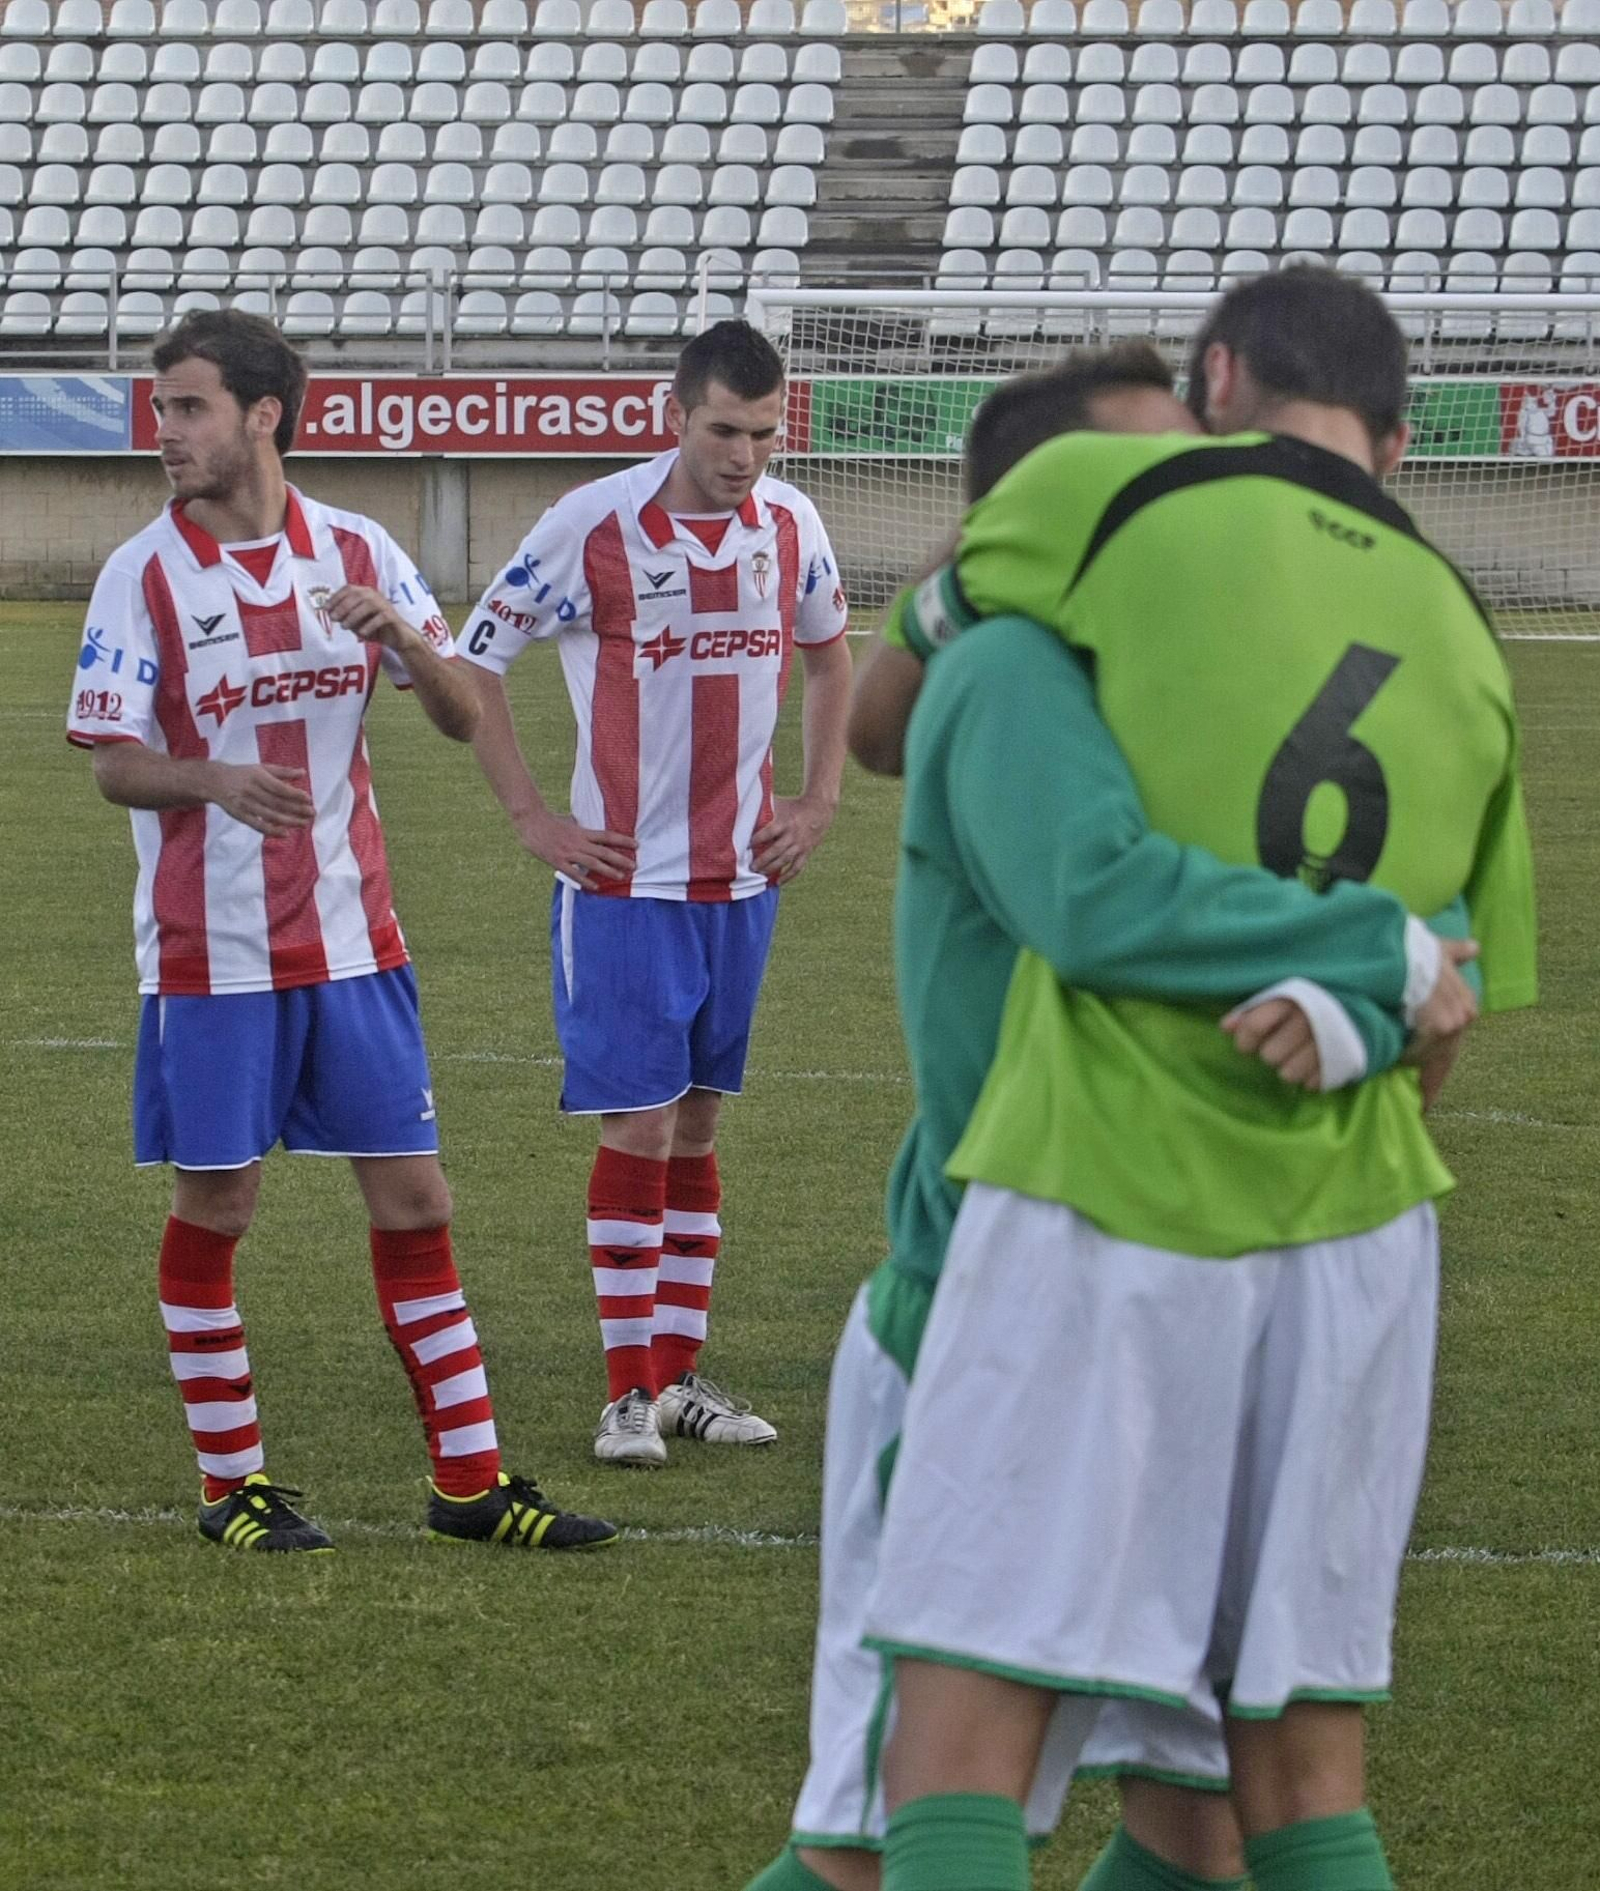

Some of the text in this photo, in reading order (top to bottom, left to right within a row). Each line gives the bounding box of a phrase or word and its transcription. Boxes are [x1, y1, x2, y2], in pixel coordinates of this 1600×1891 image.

[1563, 394, 1600, 442] C
[468, 619, 496, 656] C
[690, 630, 780, 660] CEPSA
[77, 689, 122, 721] 1912
[251, 664, 365, 708] CEPSA
[1256, 640, 1402, 884] 6
